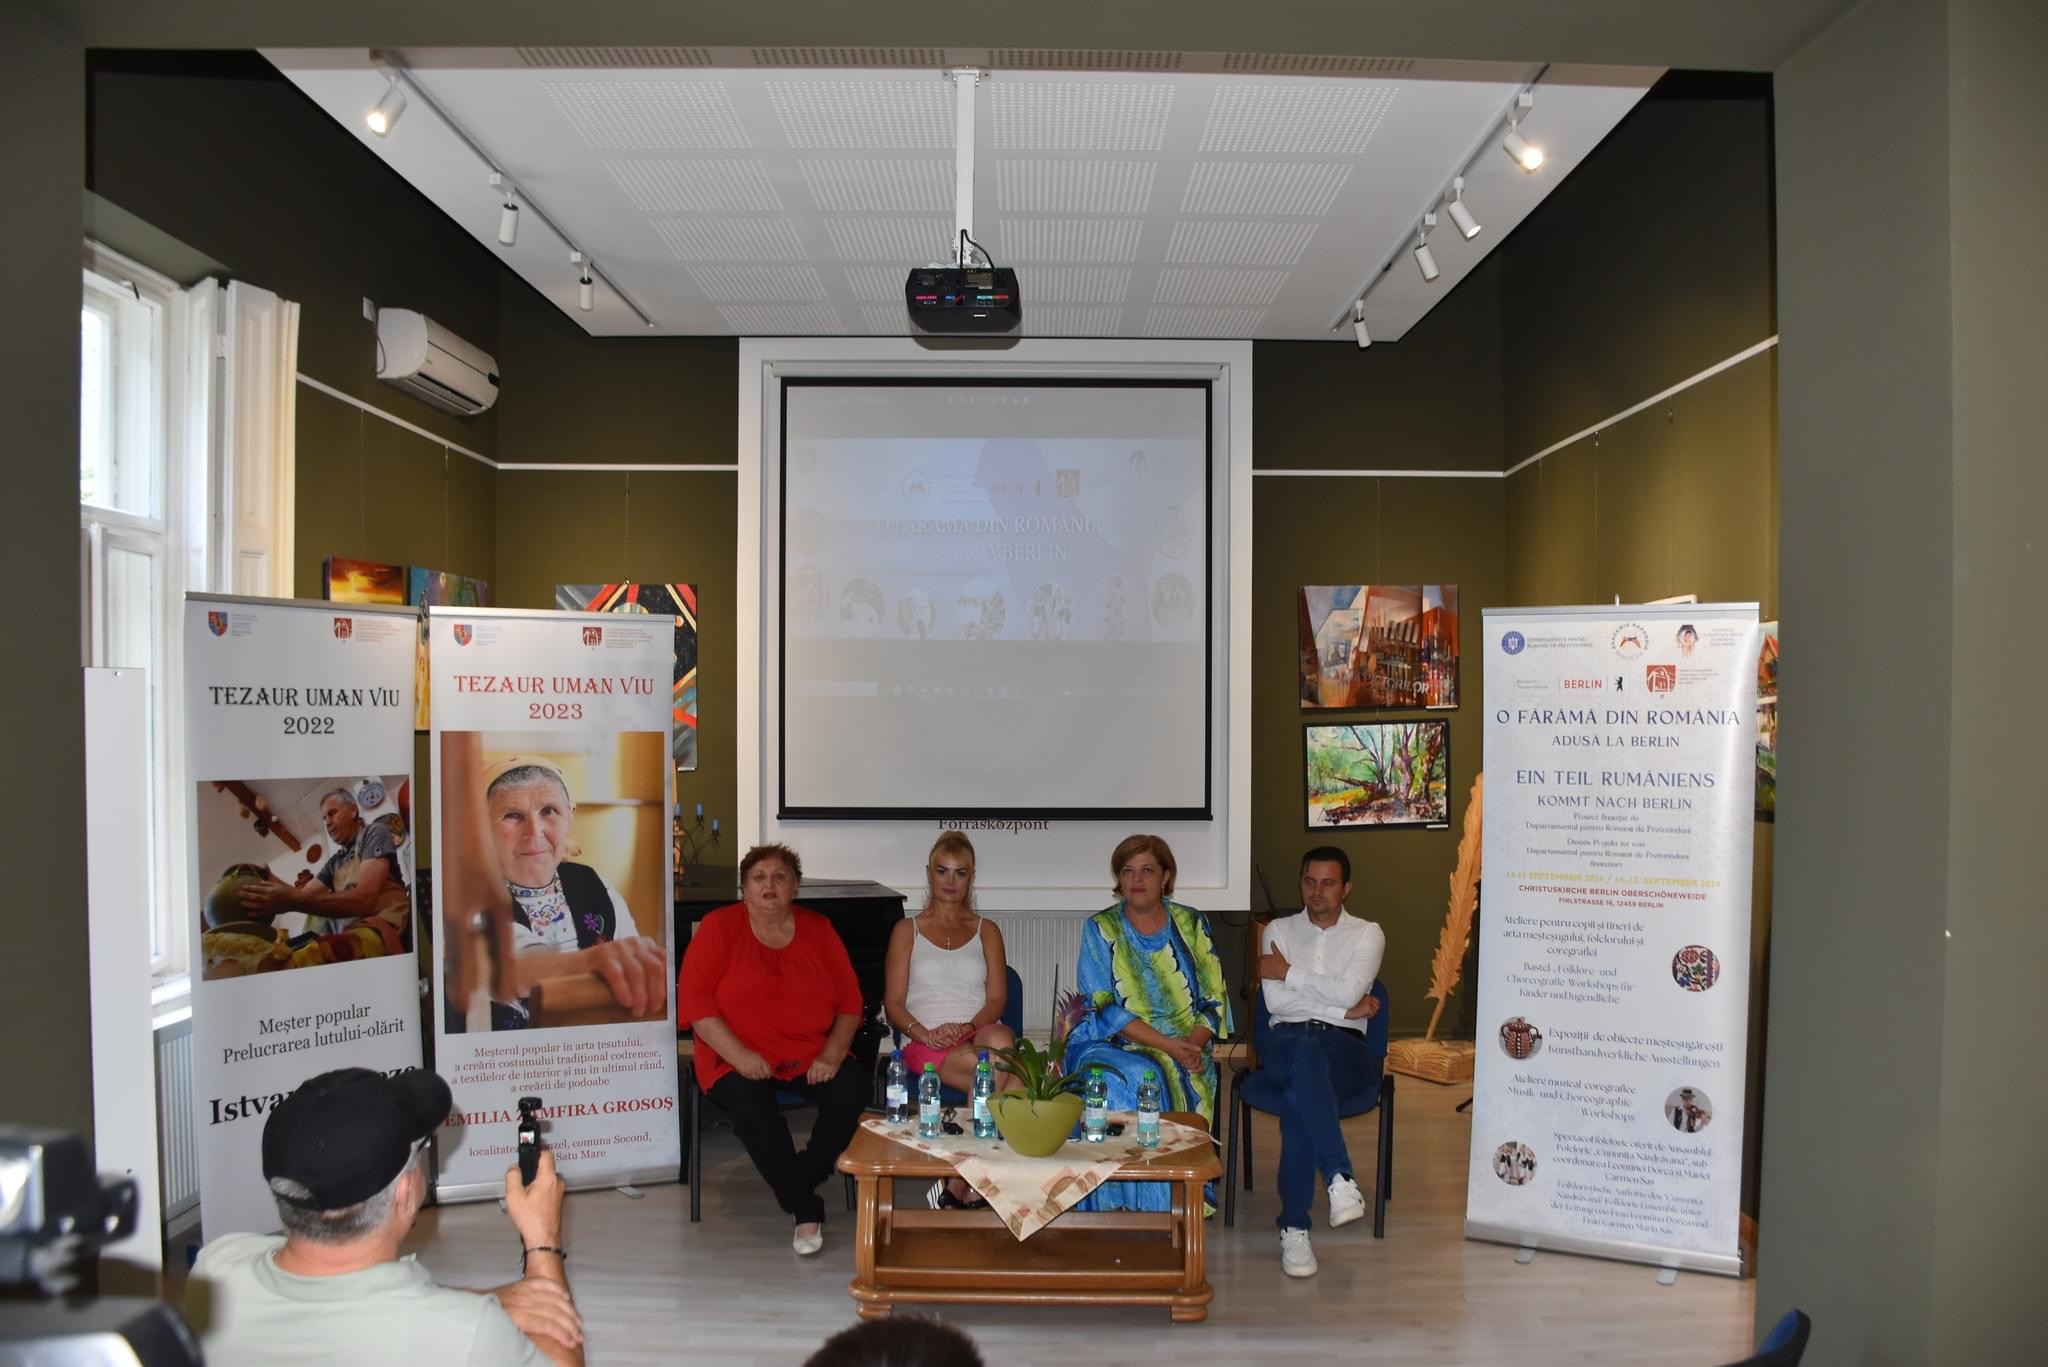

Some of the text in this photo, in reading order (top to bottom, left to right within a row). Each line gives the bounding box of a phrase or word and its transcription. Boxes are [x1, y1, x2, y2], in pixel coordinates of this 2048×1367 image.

[453, 676, 654, 695] TEZAUR UMAN VIU
[1564, 679, 1602, 689] BERLIN
[209, 686, 401, 707] TEZAUR UMAN VIU
[529, 703, 582, 720] 2023
[1497, 710, 1510, 724] O
[1606, 710, 1638, 725] DIN
[283, 716, 335, 735] 2022
[1607, 736, 1624, 747] LA
[1631, 736, 1680, 747] BERLIN
[1517, 770, 1545, 784] EIN
[1554, 771, 1593, 785] TEIL
[1538, 795, 1692, 809] KOMMT NACH BERLIN
[1518, 885, 1588, 894] CHRISTUSKIRCHE
[1590, 888, 1618, 896] BERLIN
[1540, 919, 1571, 928] pentru
[1633, 921, 1645, 931] de
[1503, 930, 1521, 939] arta
[1599, 967, 1617, 977] und
[1568, 978, 1619, 992] Workshops
[1550, 991, 1568, 1000] und
[259, 1004, 371, 1036] Meșter popular
[223, 1018, 405, 1065] Prelucrarea lutului-olărit
[1593, 1031, 1605, 1041] de
[1607, 1033, 1644, 1045] obiecte
[474, 1045, 519, 1058] Meșterul
[522, 1042, 560, 1056] popular
[575, 1041, 594, 1050] arta
[454, 1064, 461, 1072] a
[463, 1060, 496, 1071] creării
[498, 1056, 554, 1068] costumului
[557, 1051, 609, 1065] tradițional
[1651, 1053, 1721, 1070] Ausstellungen
[451, 1077, 458, 1085] a
[460, 1072, 505, 1084] textilelor
[508, 1070, 521, 1080] de
[523, 1068, 560, 1079] interior
[574, 1067, 587, 1076] nu
[602, 1062, 637, 1073] ultimul
[553, 1079, 566, 1089] de
[568, 1077, 610, 1090] podoabe
[1539, 1089, 1558, 1099] und
[209, 1089, 295, 1126] Istva
[445, 1109, 512, 1127] EMILIA
[603, 1097, 673, 1114] GROSOȘ
[1581, 1107, 1635, 1123] Workshops
[573, 1138, 611, 1149] comuna
[1654, 1142, 1667, 1151] de
[556, 1149, 606, 1162] Satu Mare
